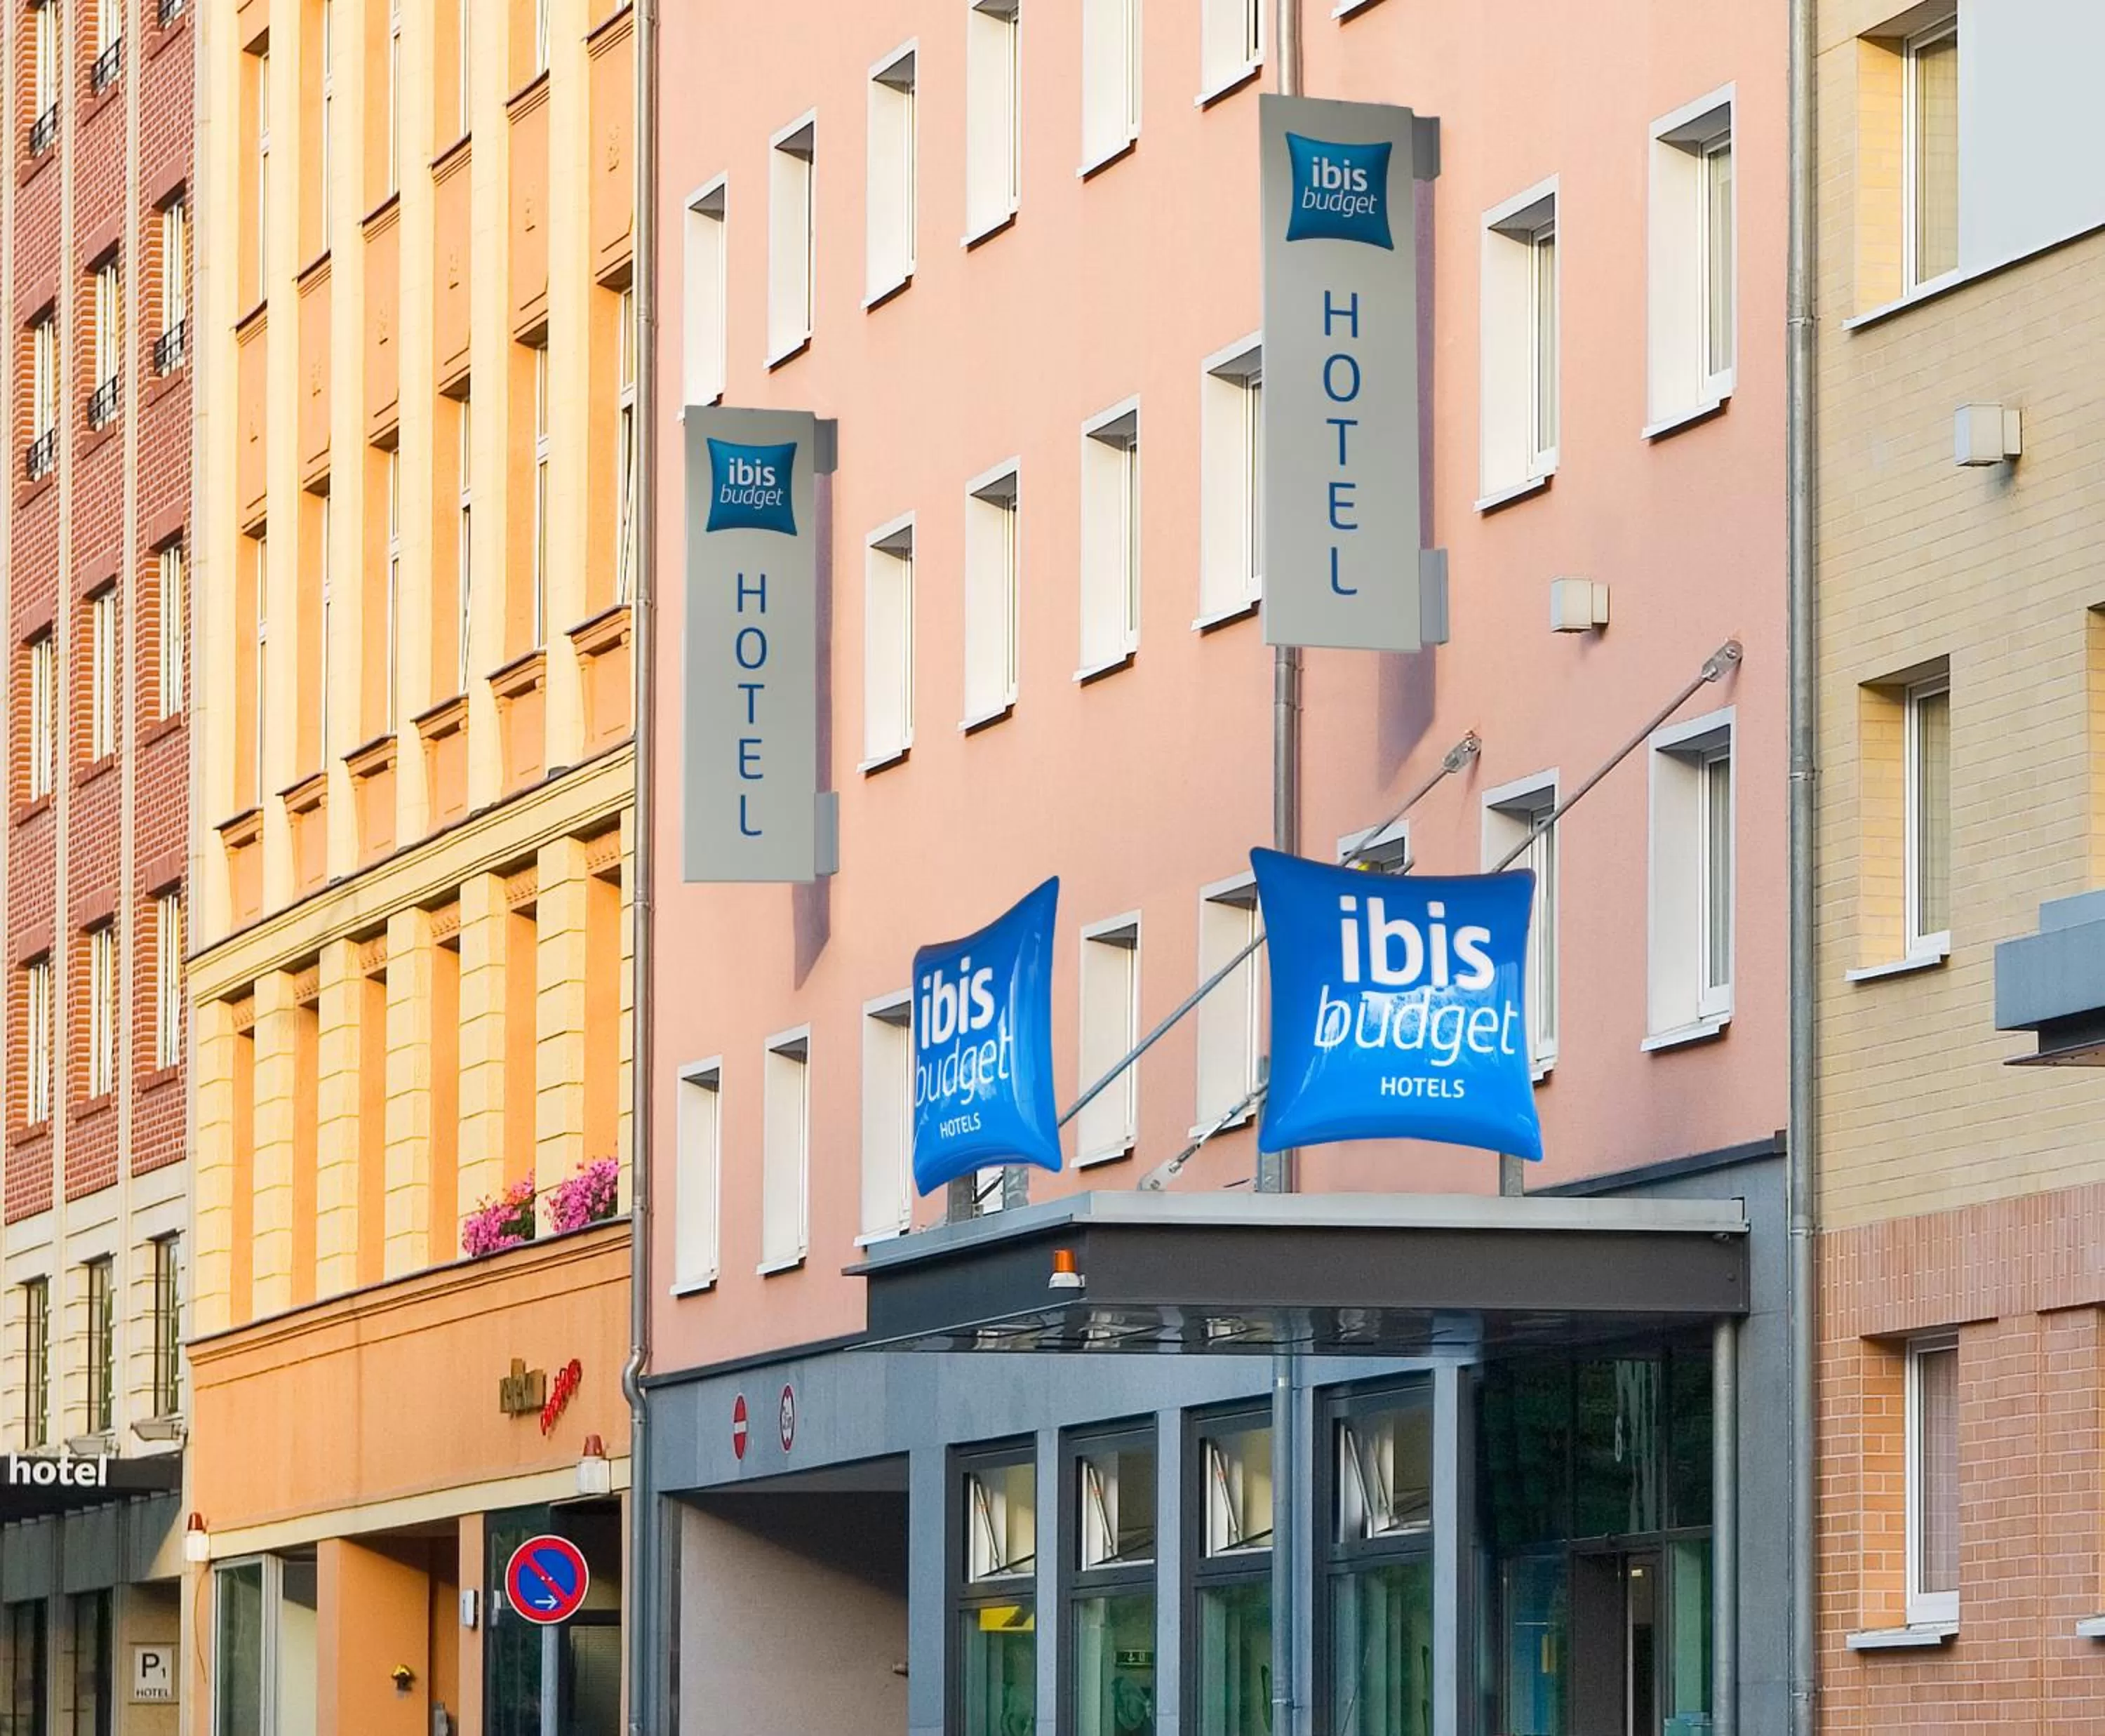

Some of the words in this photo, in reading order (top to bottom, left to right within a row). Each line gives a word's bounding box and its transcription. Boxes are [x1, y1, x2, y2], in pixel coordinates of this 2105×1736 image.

[1312, 156, 1368, 192] ibis
[1302, 186, 1377, 218] budget
[1323, 289, 1360, 596] HOTEL
[729, 457, 775, 486] ibis
[719, 483, 784, 509] budget
[735, 573, 768, 836] HOTEL
[1339, 895, 1495, 991] ibis
[921, 955, 995, 1050] ibis
[1314, 984, 1518, 1067] budget
[914, 1027, 1013, 1107] budget
[1379, 1076, 1465, 1098] HOTELS
[939, 1111, 982, 1140] HOTELS
[8, 1450, 108, 1487] hotel
[136, 1688, 168, 1697] HOTEL
